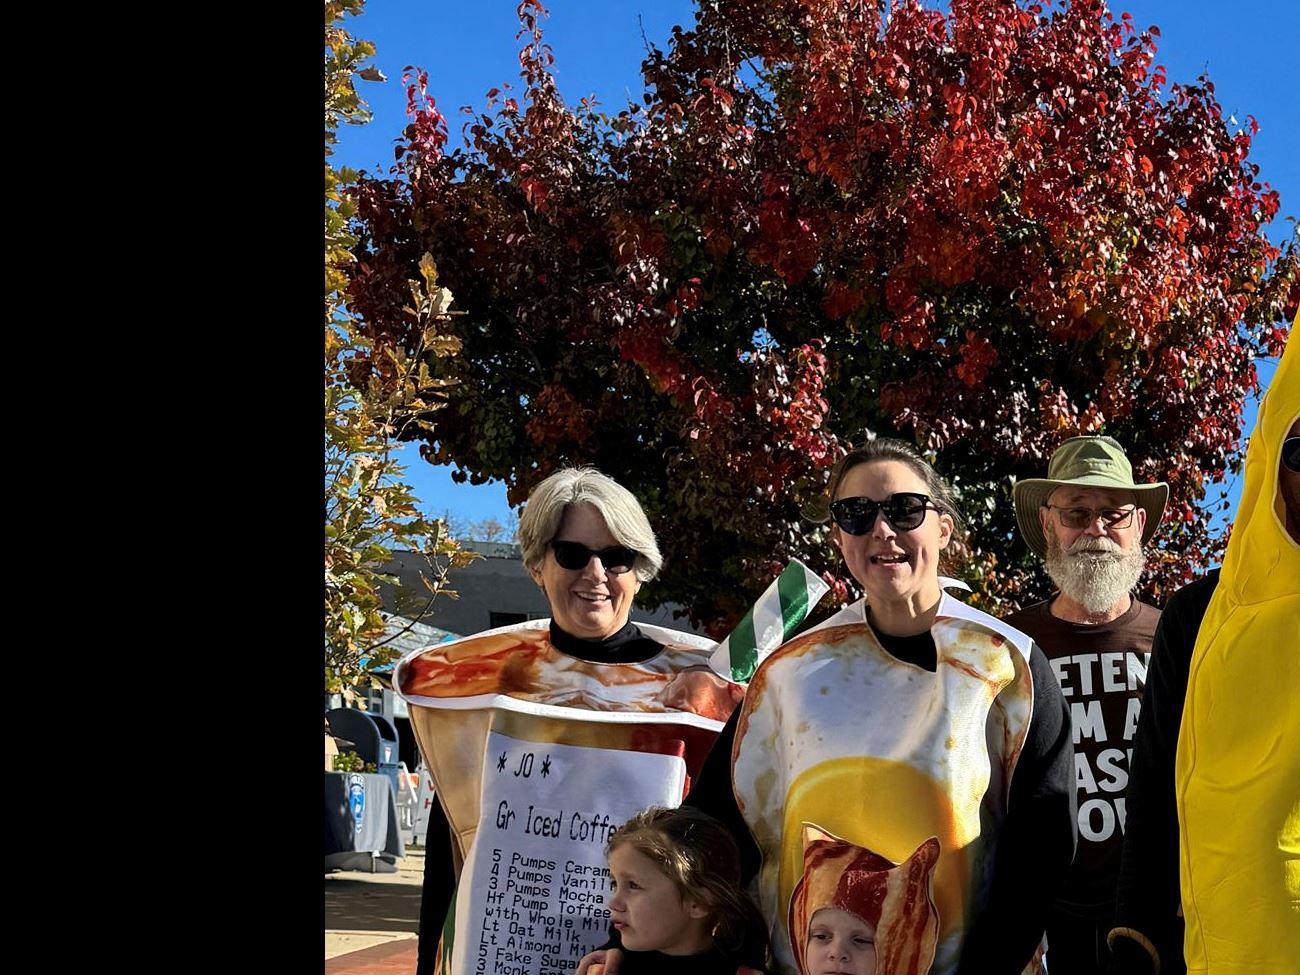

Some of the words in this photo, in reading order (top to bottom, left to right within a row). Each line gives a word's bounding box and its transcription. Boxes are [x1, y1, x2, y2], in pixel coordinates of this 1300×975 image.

[1050, 652, 1152, 696] ETEN
[1071, 700, 1108, 744] M
[514, 752, 534, 778] JO
[1074, 748, 1134, 794] AS
[496, 800, 515, 830] Gr
[524, 805, 563, 838] Iced
[569, 812, 617, 844] Coffe
[491, 862, 500, 876] 4
[508, 866, 552, 884] Pumps
[492, 849, 502, 862] 5
[512, 852, 556, 870] Pumps
[565, 860, 610, 877] Caram
[489, 876, 498, 890] 3
[506, 879, 550, 897] Pumps
[559, 886, 604, 904] Mocha
[486, 890, 505, 904] Hf
[512, 894, 548, 910] Pump
[558, 900, 612, 918] Toffee
[482, 917, 500, 932] Lt
[509, 921, 534, 937] Oat
[544, 926, 580, 942] Milk
[486, 906, 520, 920] with
[529, 910, 574, 928] Whole
[582, 917, 608, 932] Mil
[479, 944, 488, 957] 5
[496, 948, 532, 964] Fake
[480, 930, 498, 945] Lt
[506, 935, 560, 954] Almond
[477, 958, 486, 971] 3
